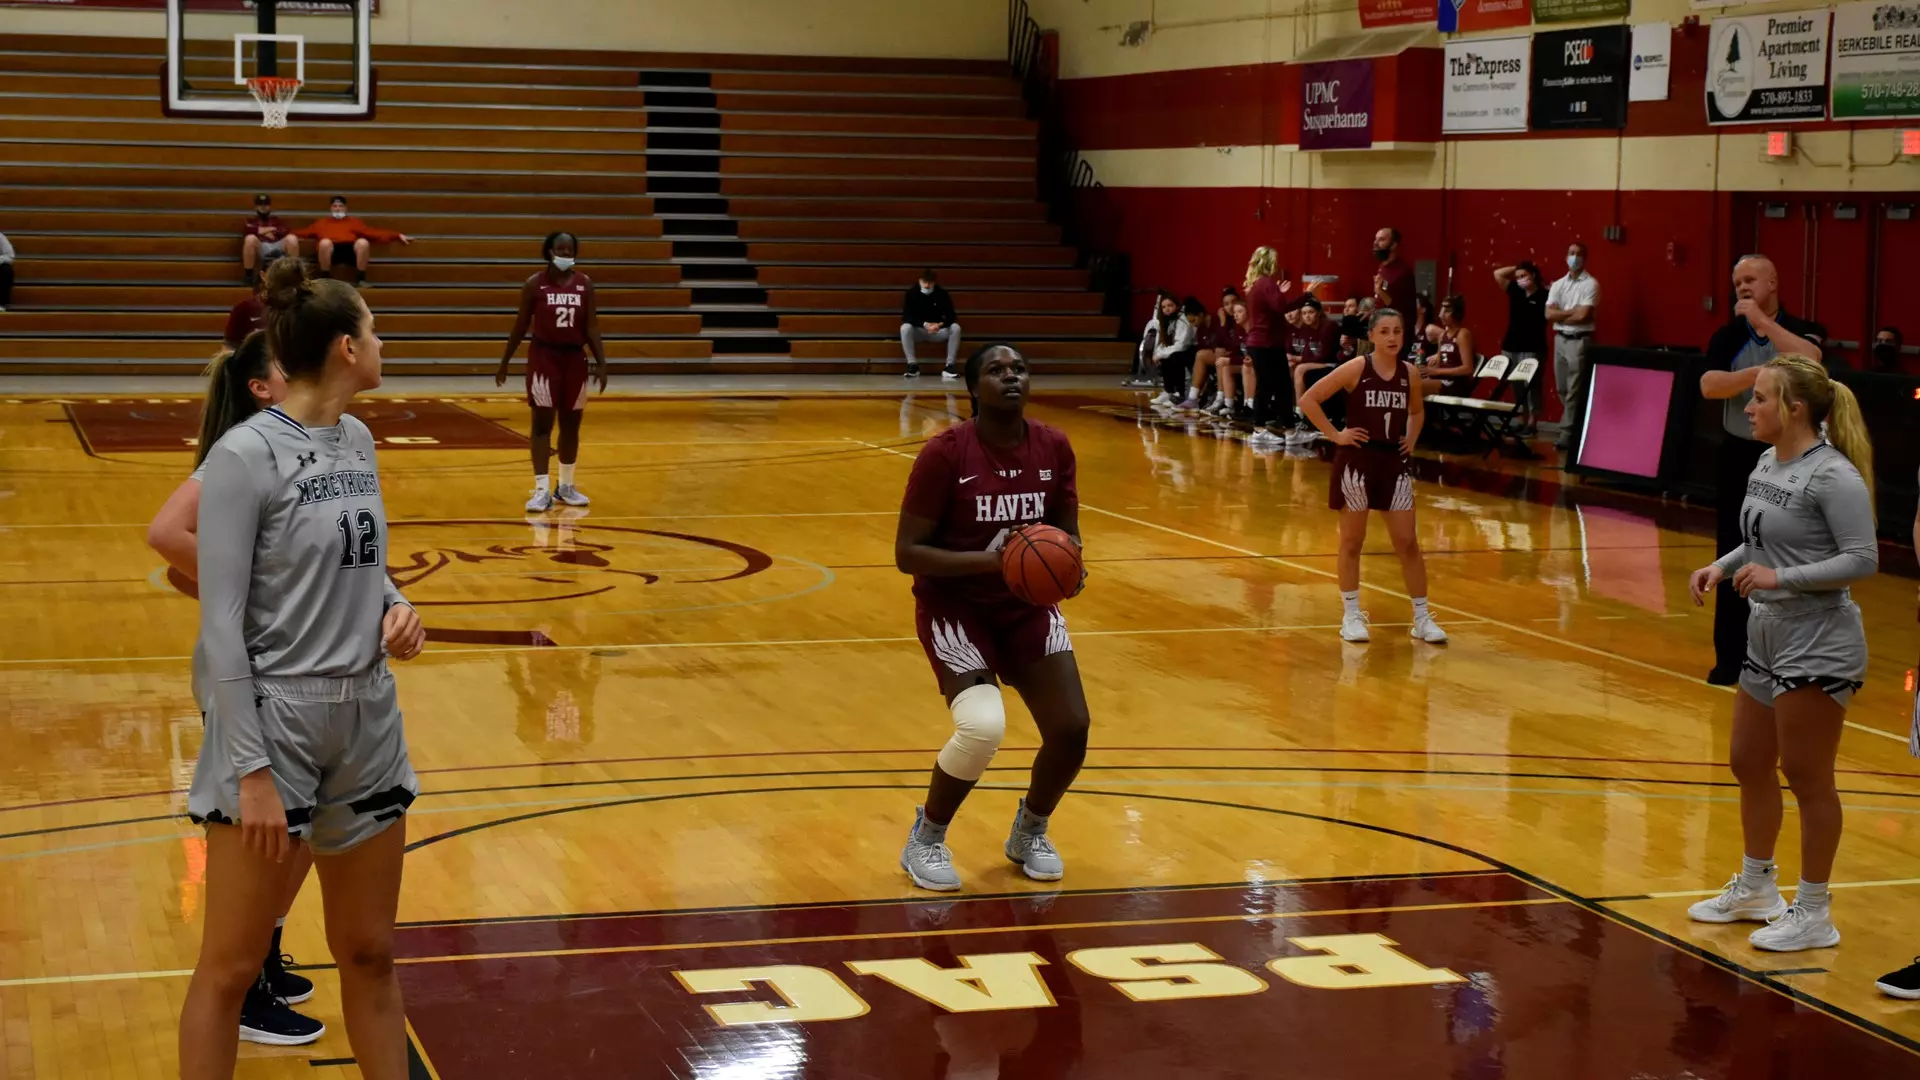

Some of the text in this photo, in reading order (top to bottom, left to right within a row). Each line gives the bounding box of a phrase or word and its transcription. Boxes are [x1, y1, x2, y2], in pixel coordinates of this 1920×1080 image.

[1767, 16, 1814, 36] Premier
[1564, 38, 1594, 66] PSECU
[1758, 38, 1821, 60] Apartment
[1838, 36, 1893, 52] BERKEBILE
[1450, 56, 1521, 80] The Express
[1769, 60, 1807, 81] Living
[1305, 80, 1340, 105] UPMC
[1760, 89, 1813, 104] 570-893-1833
[1861, 82, 1920, 98] 570-748-28
[1303, 105, 1368, 135] Susquehanna
[547, 293, 581, 306] HAVEN
[555, 307, 575, 328] 21
[1364, 390, 1407, 409] HAVEN
[1383, 411, 1392, 440] 1
[975, 491, 1046, 522] HAVEN
[337, 508, 379, 569] 12
[1743, 506, 1764, 550] 14
[671, 932, 1468, 1027] PSAC
